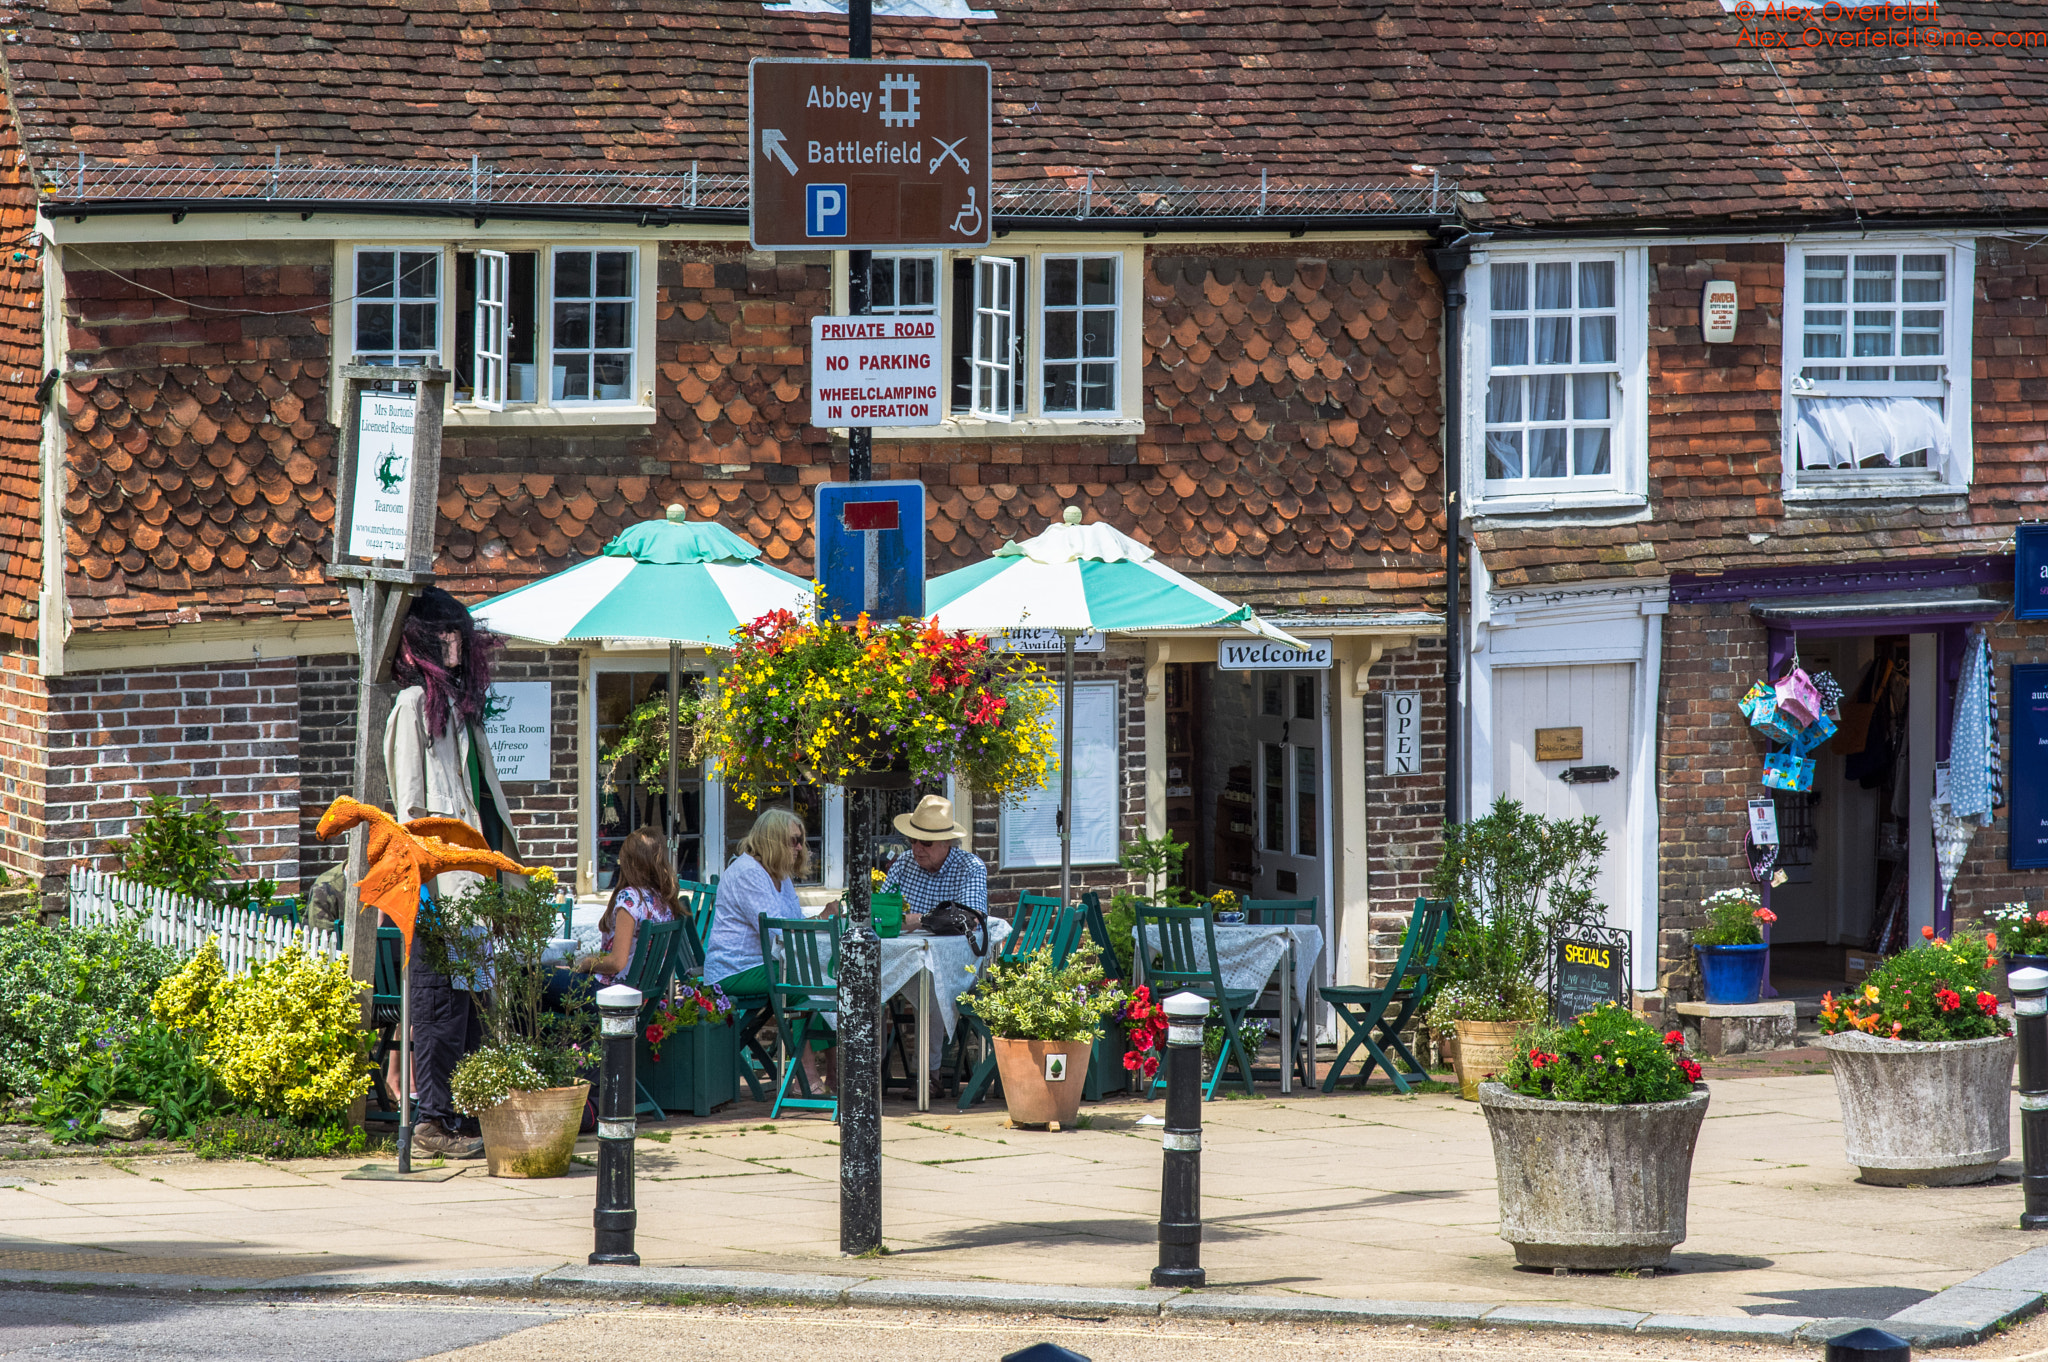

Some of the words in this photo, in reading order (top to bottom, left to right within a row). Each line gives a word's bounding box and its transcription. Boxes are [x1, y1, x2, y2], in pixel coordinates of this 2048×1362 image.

[806, 85, 873, 113] Abbey
[808, 140, 921, 164] Battlefield
[816, 190, 840, 232] P
[822, 323, 885, 338] PRIVATE
[894, 322, 935, 337] ROAD
[826, 356, 849, 371] NO
[859, 354, 931, 370] PARKING
[819, 386, 937, 401] WHEELCLAMPING
[374, 403, 388, 416] Mrs
[388, 404, 414, 418] Burton's
[828, 406, 842, 418] IN
[850, 404, 929, 418] OPERATION
[361, 419, 389, 433] Licenced
[390, 421, 415, 435] Restaur
[374, 500, 404, 514] Tearoom
[1226, 643, 1329, 664] Welcome
[500, 724, 516, 734] Tea
[518, 724, 545, 734] Room
[1396, 697, 1412, 773] OPEN
[491, 740, 529, 752] Alfresco
[496, 753, 506, 762] in
[1565, 944, 1610, 969] SPECIALS
